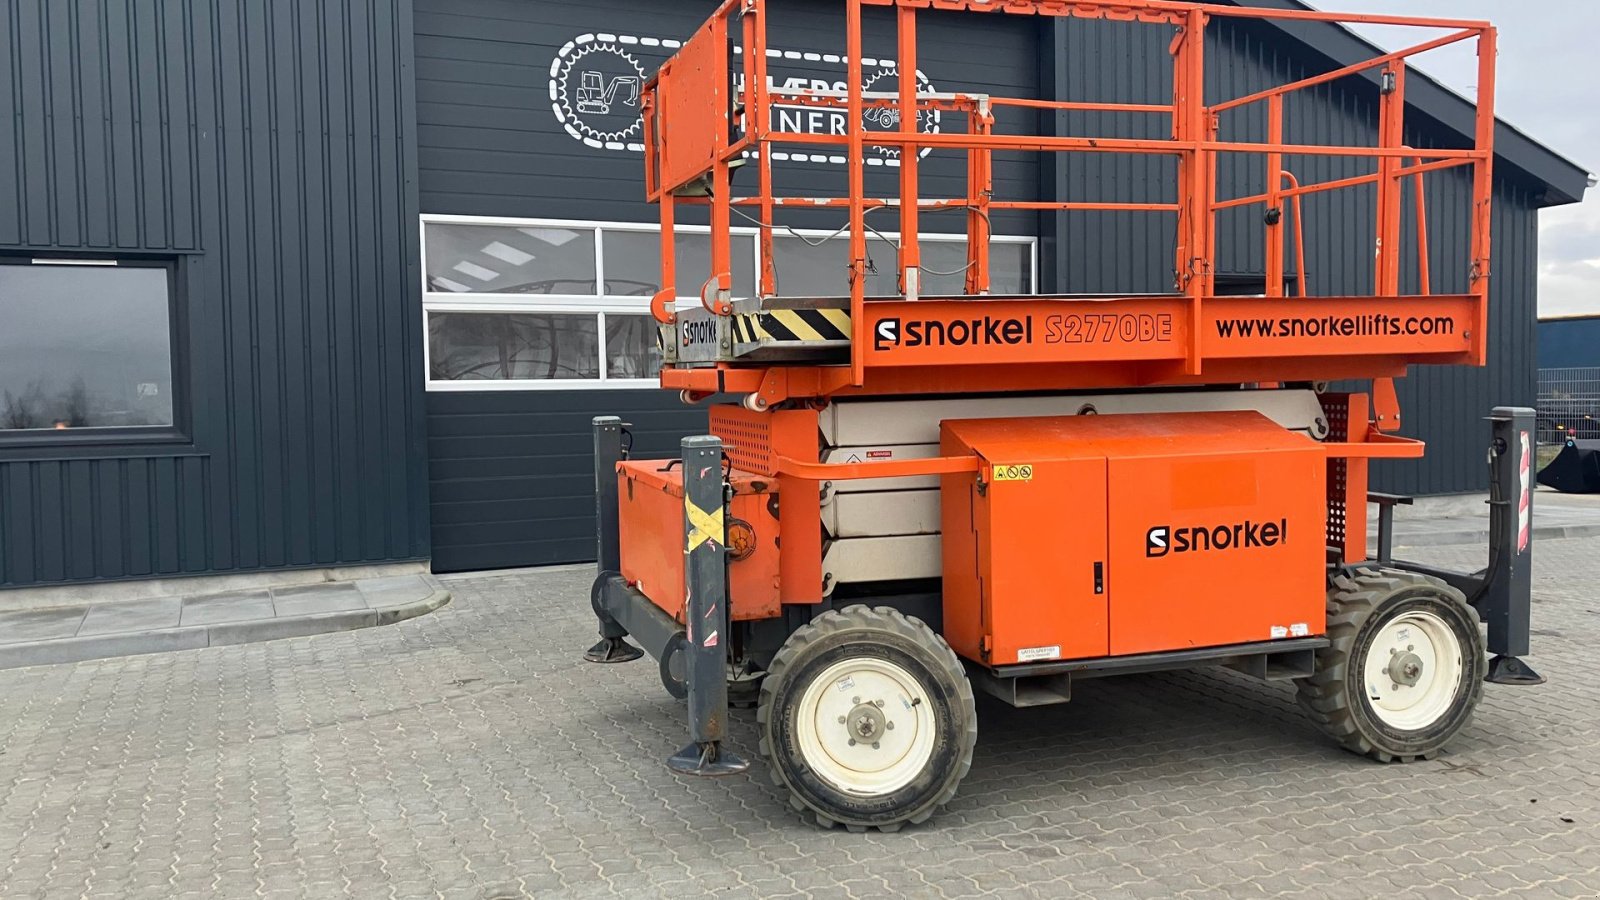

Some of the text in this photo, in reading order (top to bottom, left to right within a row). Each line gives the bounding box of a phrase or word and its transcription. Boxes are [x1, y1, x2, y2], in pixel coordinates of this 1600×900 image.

[905, 316, 1032, 347] snorkel
[1046, 314, 1172, 343] S2770BE
[1216, 314, 1454, 338] www.snorkellifts.com
[1174, 518, 1287, 553] snorkel
